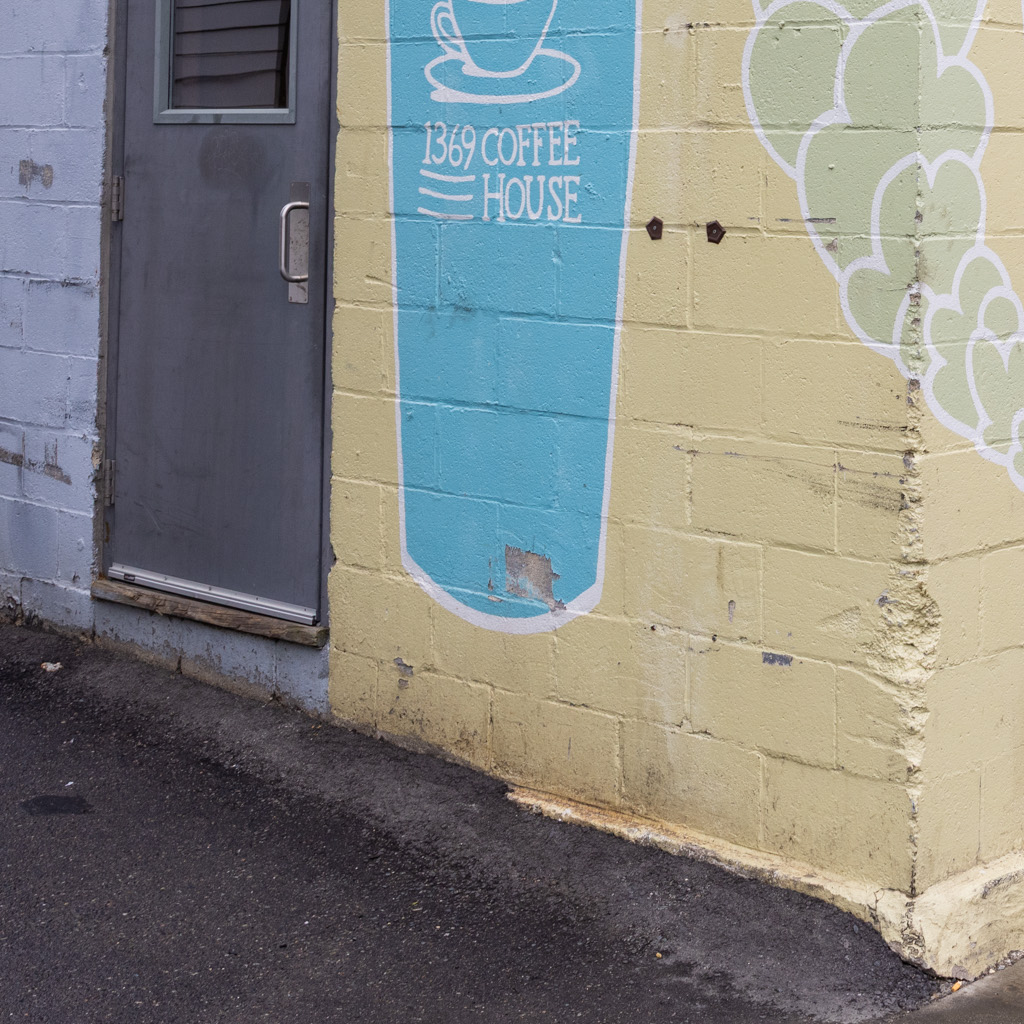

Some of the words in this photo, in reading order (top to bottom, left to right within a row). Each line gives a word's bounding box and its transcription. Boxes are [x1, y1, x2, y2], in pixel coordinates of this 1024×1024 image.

[421, 121, 478, 170] 1369
[481, 120, 581, 167] COFFEE
[481, 173, 582, 223] HOUSE
